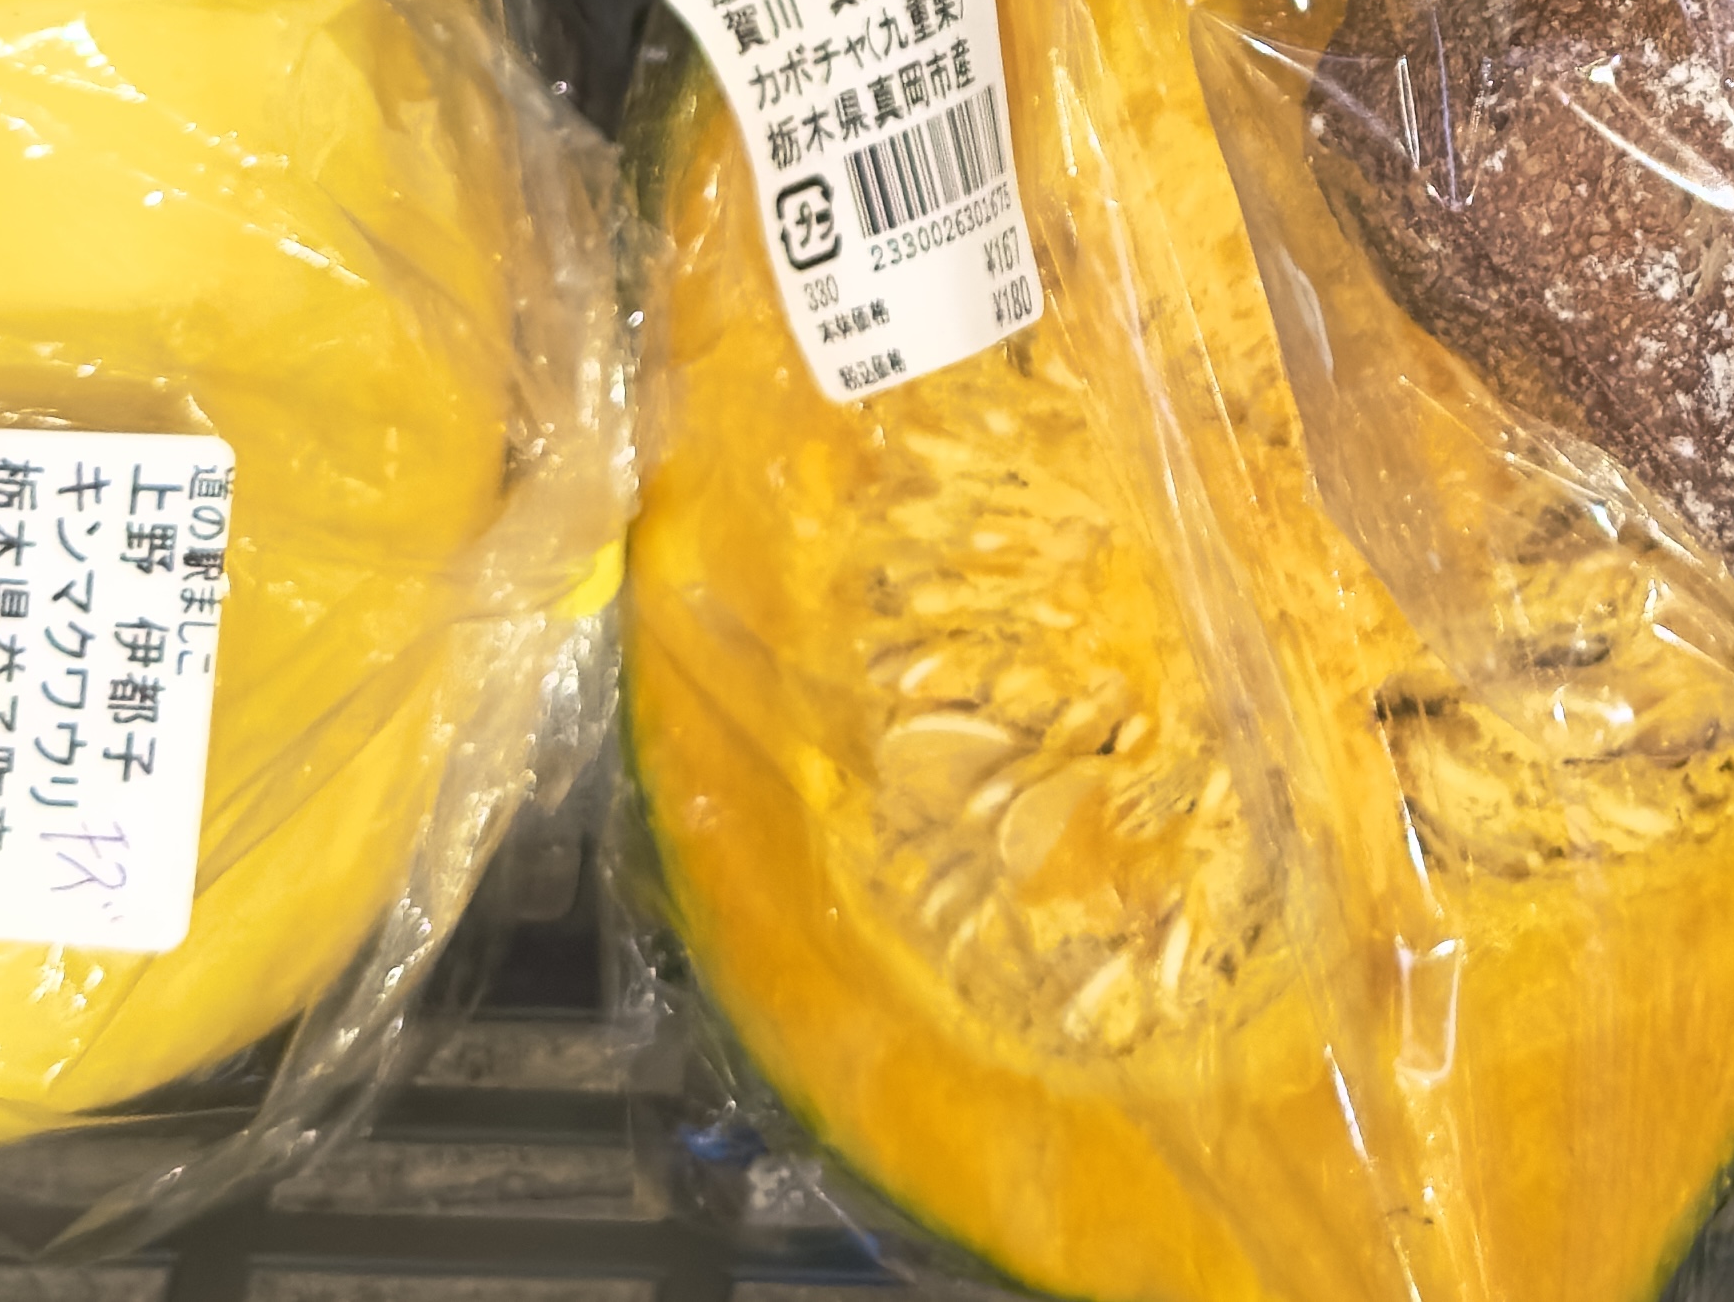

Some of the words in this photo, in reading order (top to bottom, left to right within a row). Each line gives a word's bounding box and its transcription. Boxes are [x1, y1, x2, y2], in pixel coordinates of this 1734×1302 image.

[766, 35, 976, 171] 栃木県真岡市産
[803, 274, 839, 312] 330
[871, 180, 1013, 272] 2330026301675
[118, 463, 184, 576] 上野
[176, 465, 236, 676] 道の駅ましこ
[29, 460, 112, 809] キンマクワウリ
[101, 616, 170, 783] 伊都子
